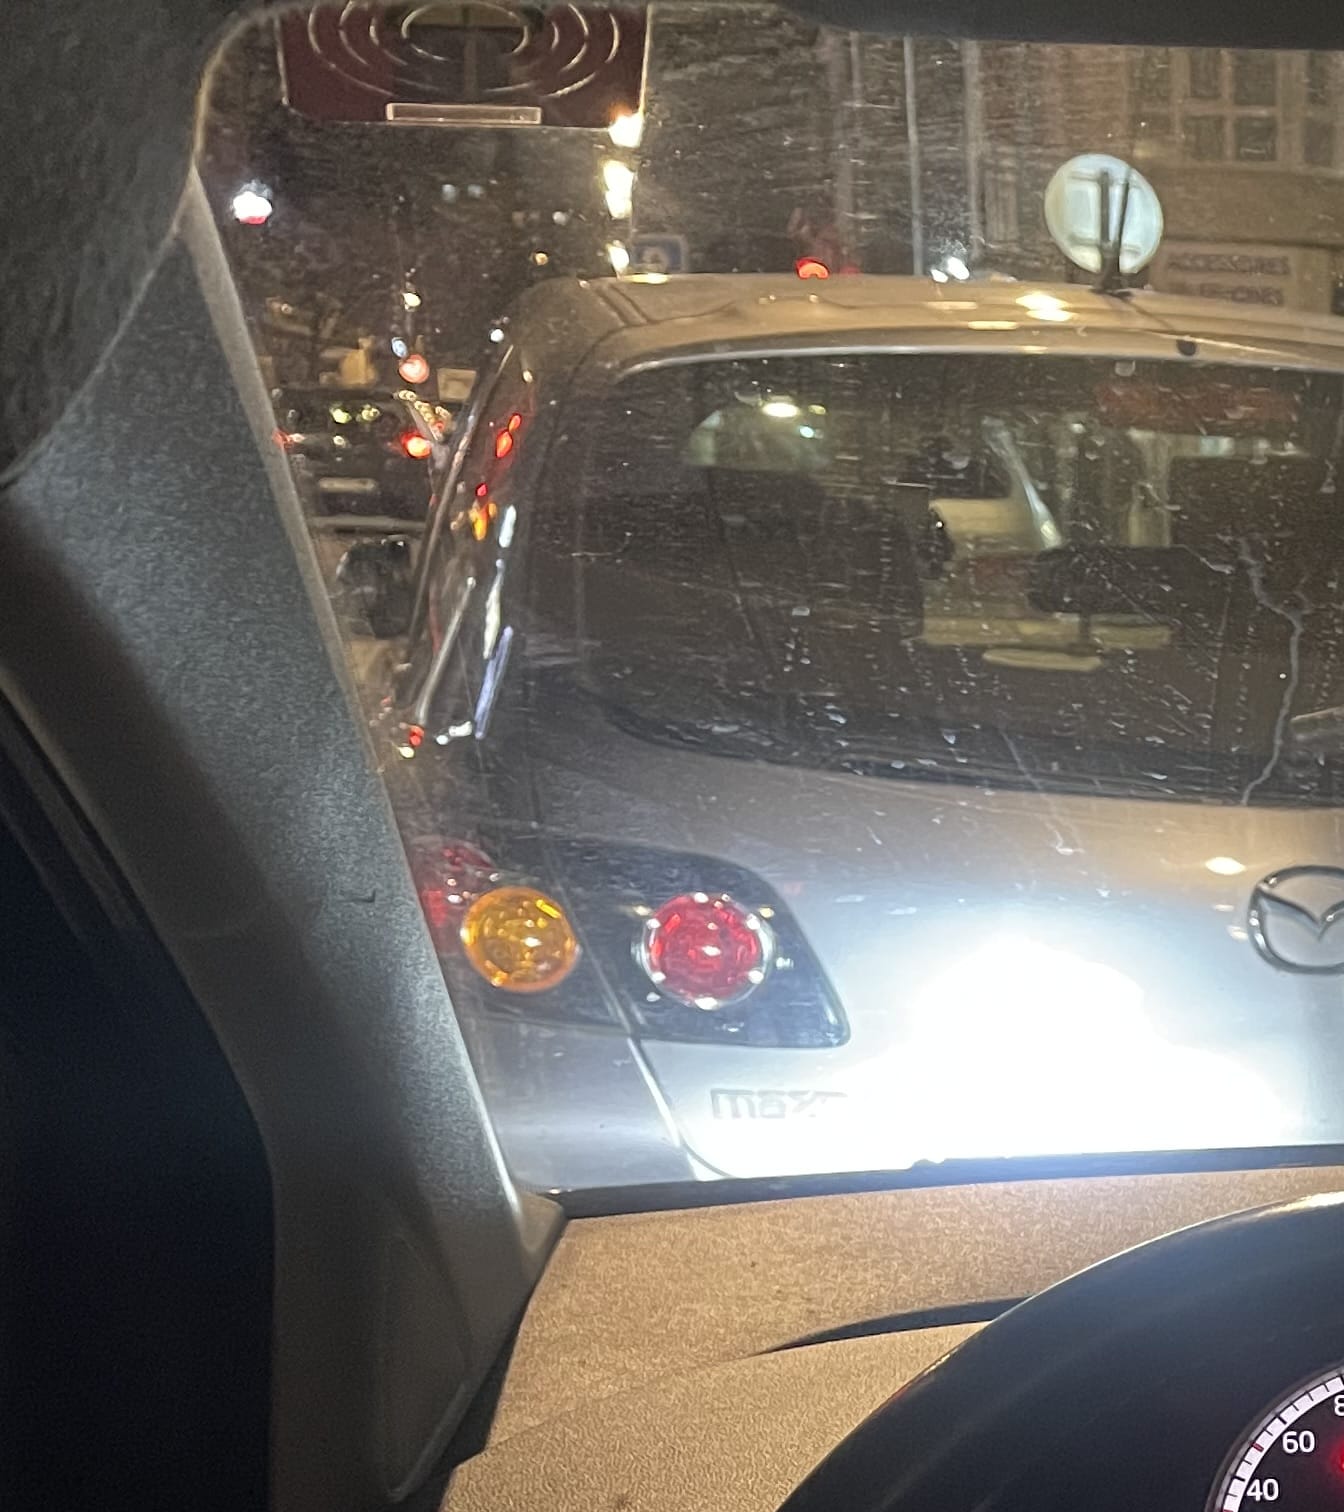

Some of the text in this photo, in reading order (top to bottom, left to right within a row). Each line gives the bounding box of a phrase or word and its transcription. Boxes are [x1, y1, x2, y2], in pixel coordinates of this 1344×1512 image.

[710, 1087, 848, 1120] maz
[1281, 1430, 1315, 1453] 60
[1246, 1478, 1279, 1501] 40
